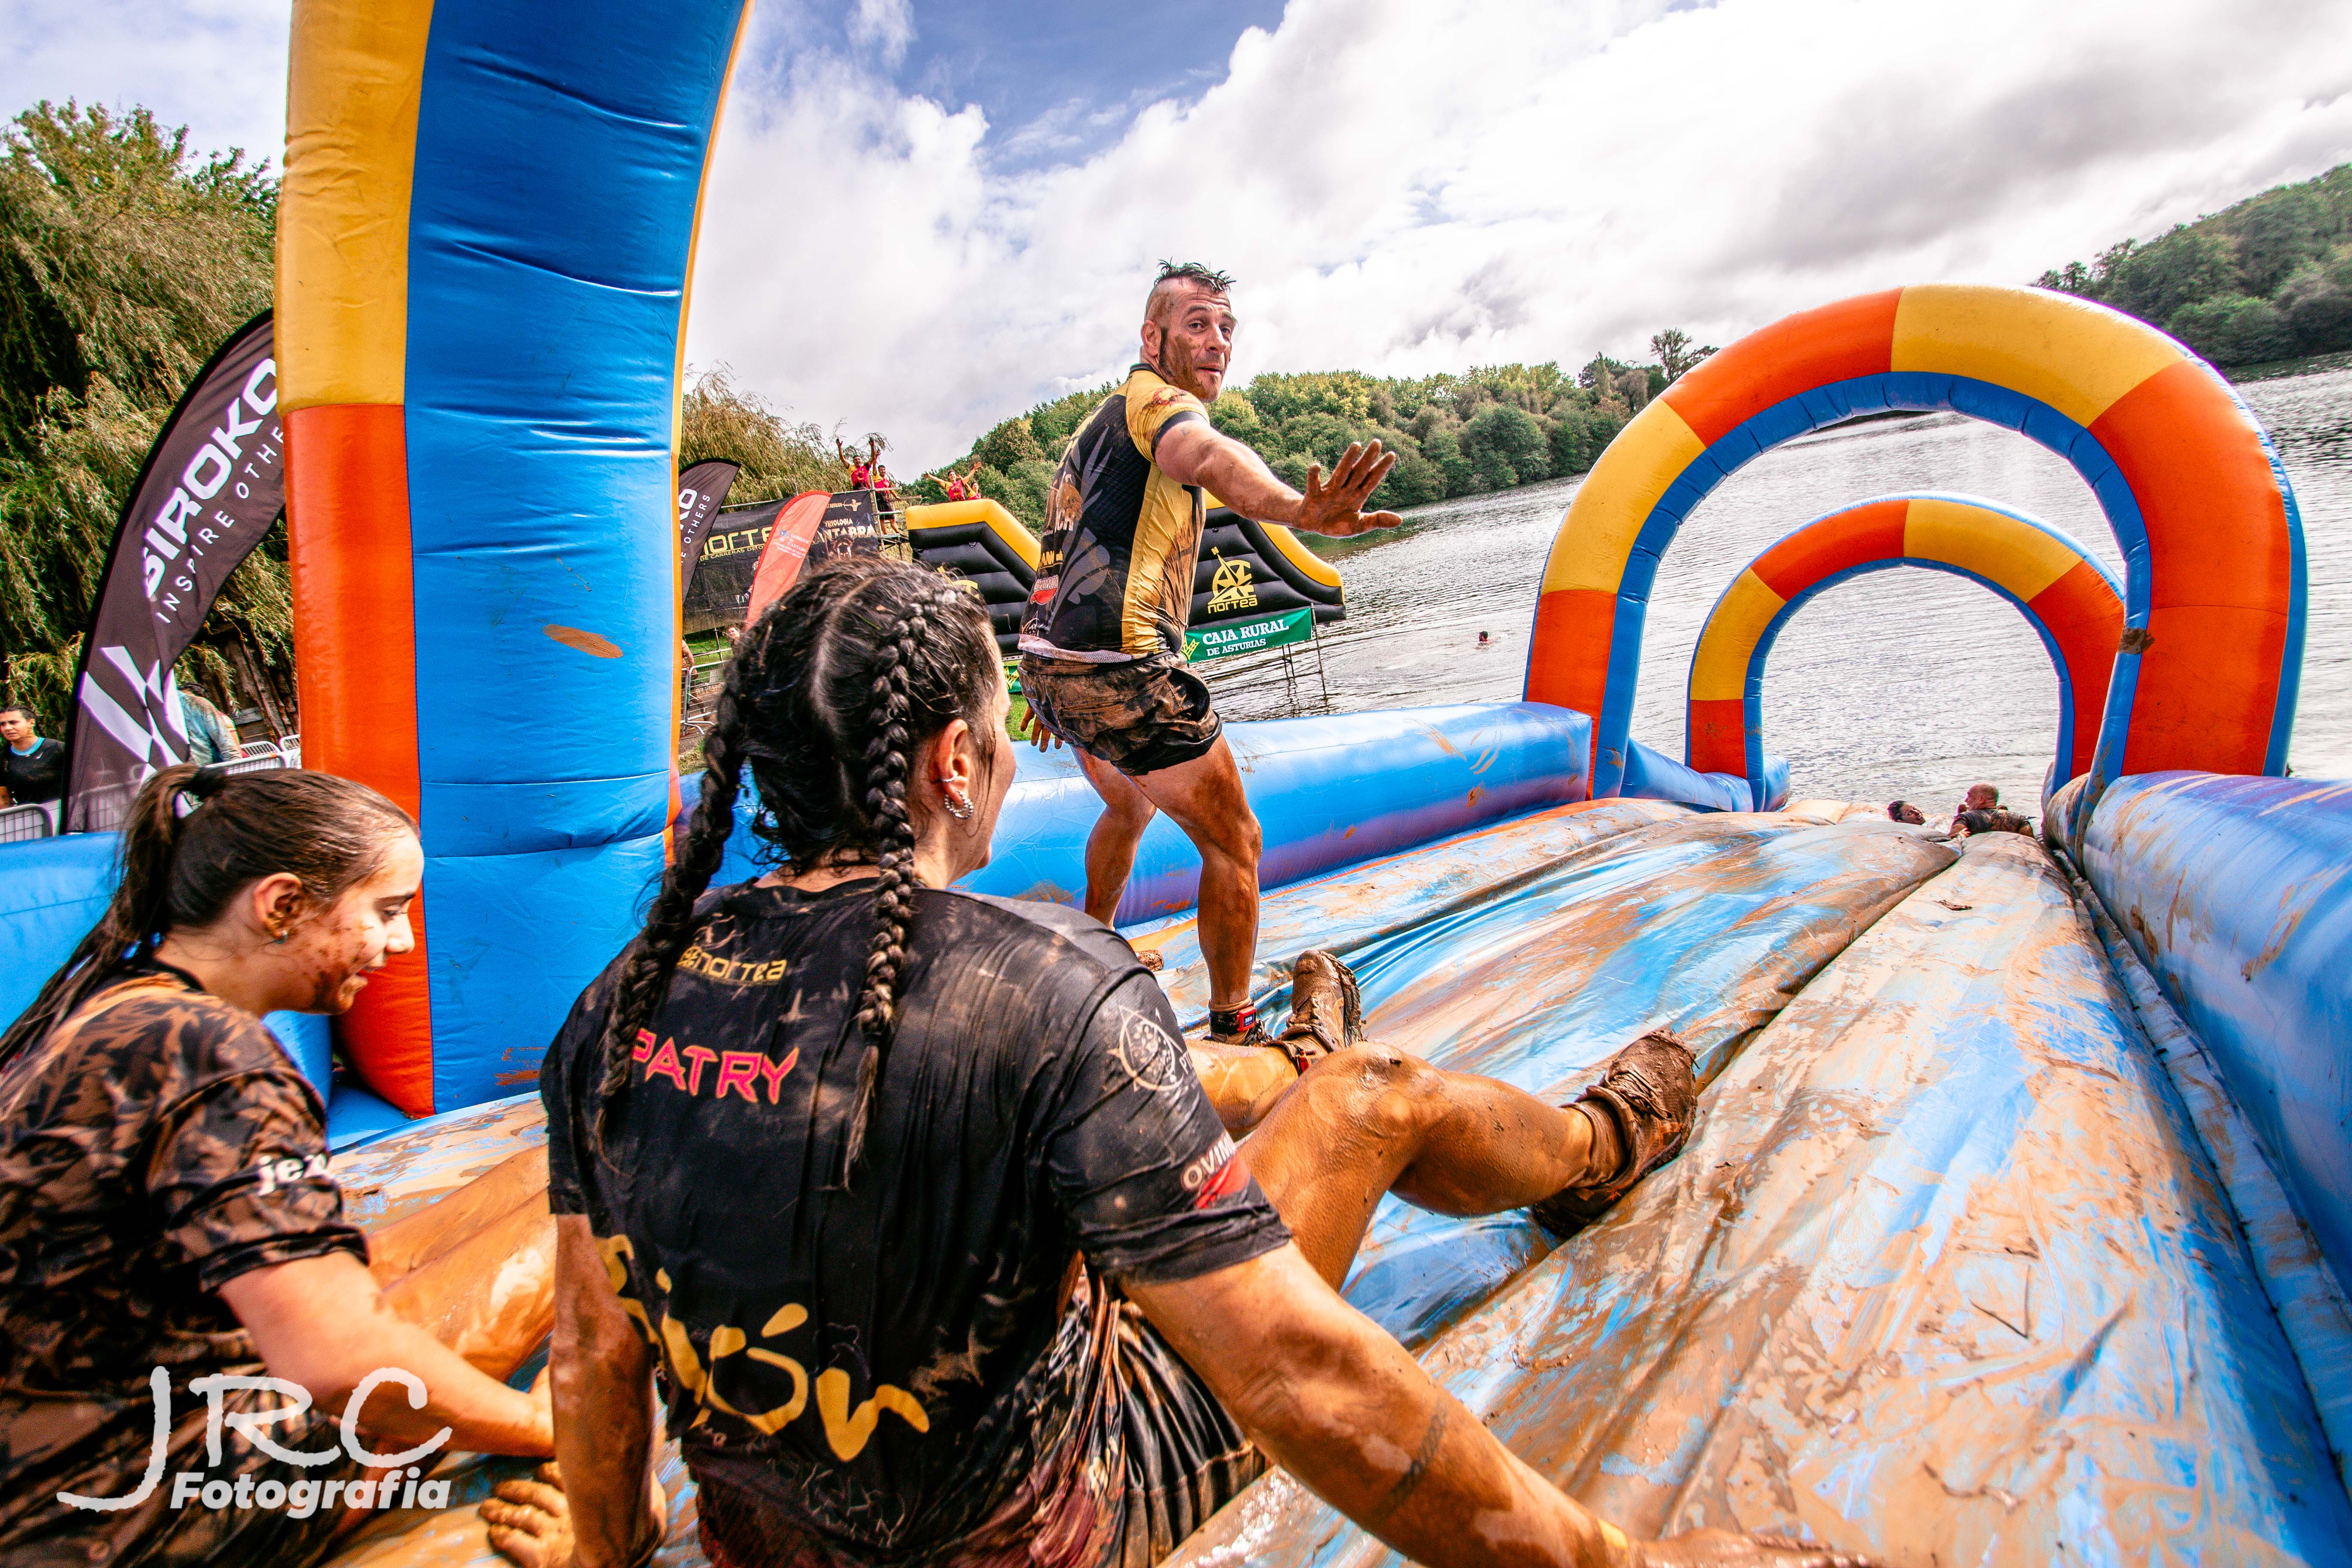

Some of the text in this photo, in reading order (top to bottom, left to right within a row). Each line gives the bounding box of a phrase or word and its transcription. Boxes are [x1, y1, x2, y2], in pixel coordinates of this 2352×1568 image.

[683, 495, 710, 544] OTHERS
[824, 518, 853, 528] TRIOLOGIA
[790, 533, 809, 544] GOBIERN
[710, 548, 745, 559] CARRERAS
[156, 510, 235, 623] INSPIRE
[1203, 619, 1289, 645] CAJA RURAL
[1206, 638, 1267, 657] DE ASTURIAS
[632, 1027, 799, 1105] PATRY
